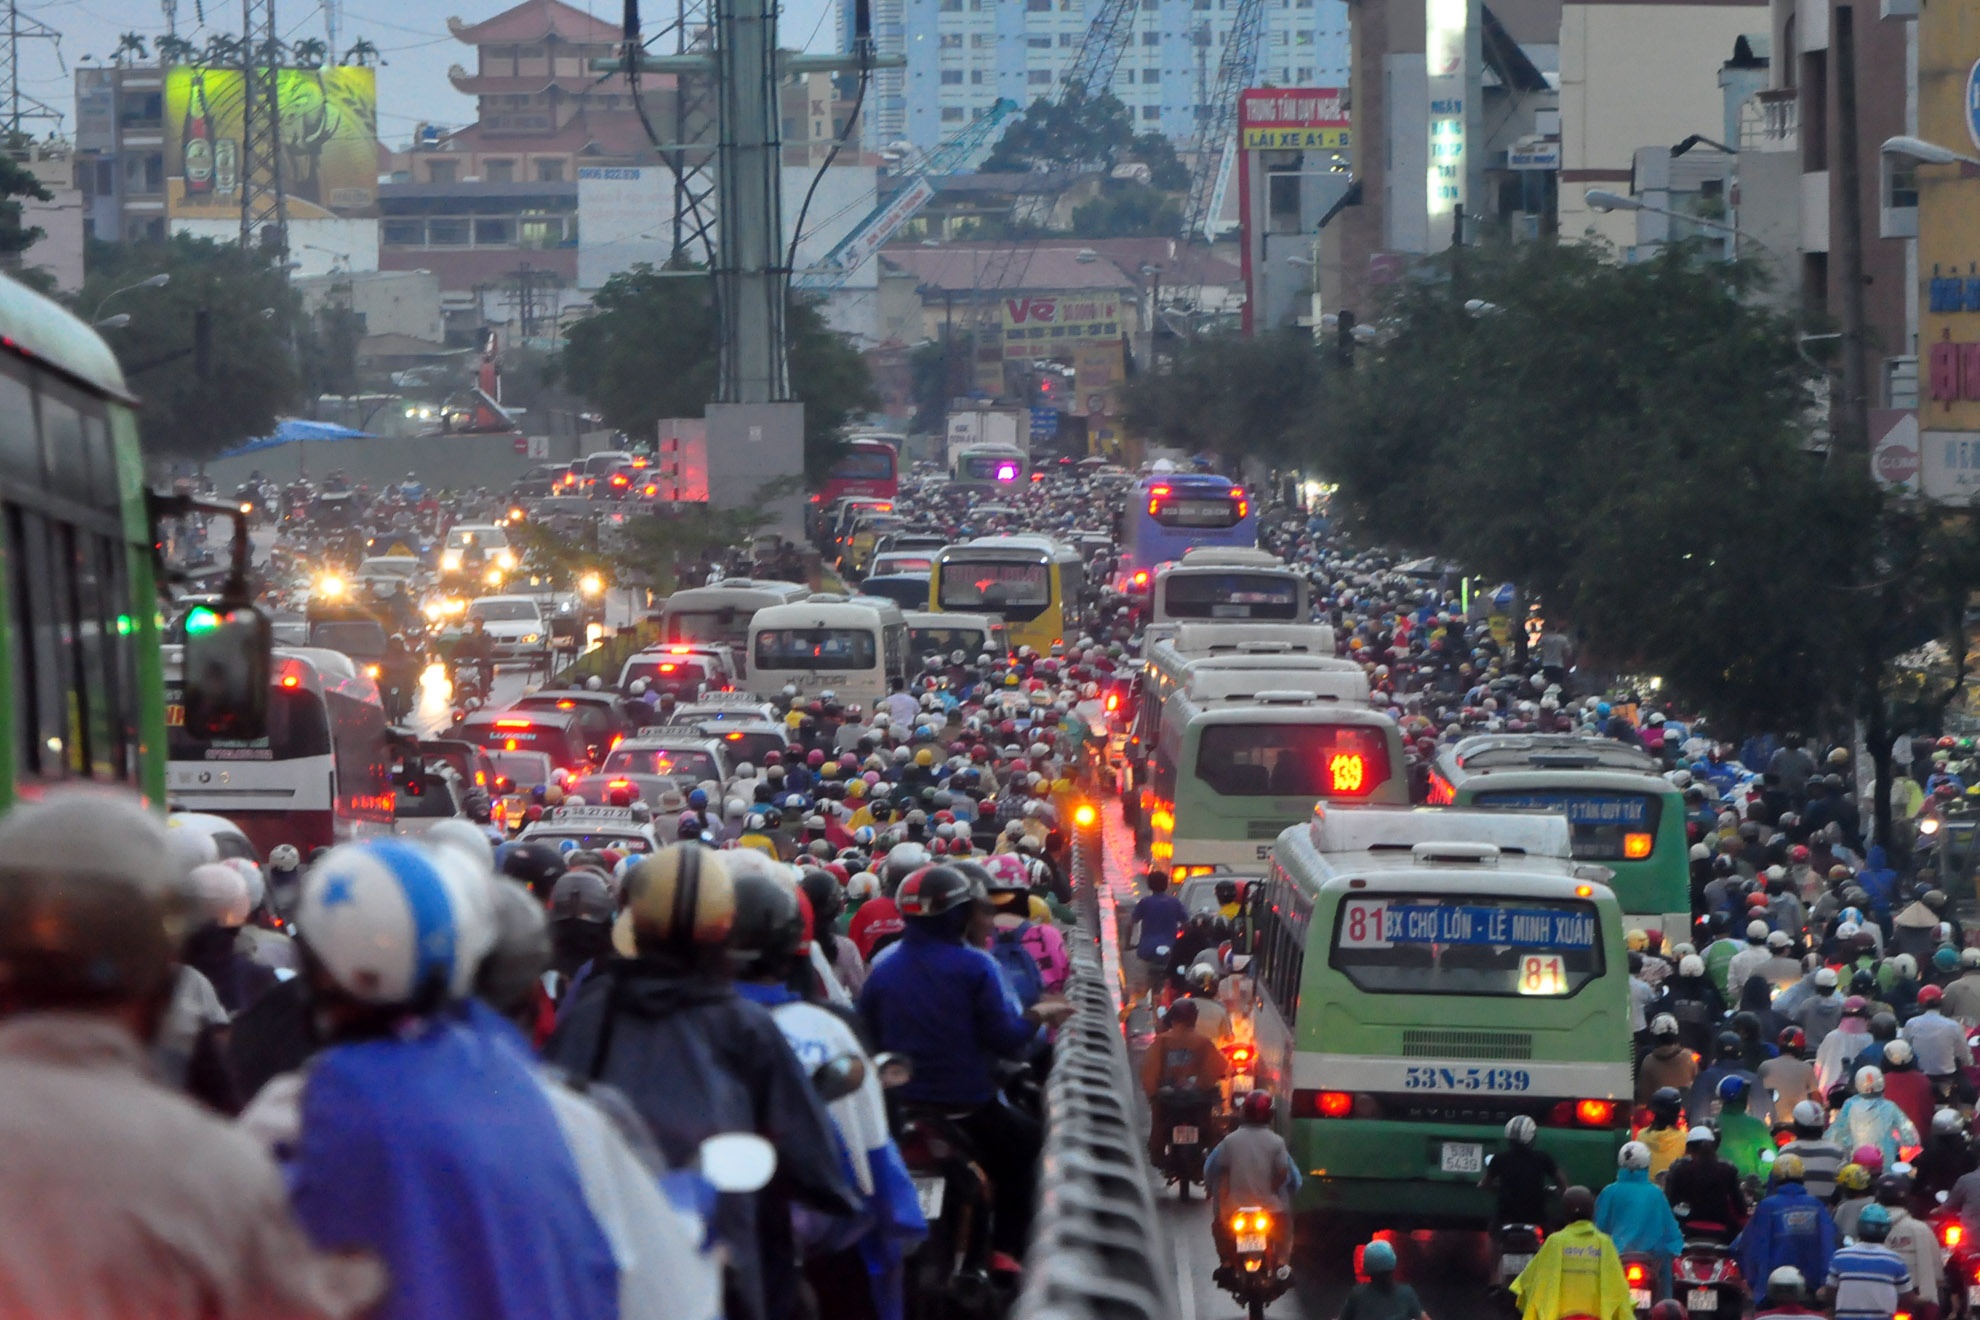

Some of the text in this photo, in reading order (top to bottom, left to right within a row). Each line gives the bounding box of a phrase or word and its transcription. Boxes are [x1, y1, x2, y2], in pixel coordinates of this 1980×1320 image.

[1249, 129, 1275, 146] LÁI
[1281, 133, 1300, 146] XE
[1306, 133, 1323, 146] A1
[1330, 754, 1363, 791] 139
[589, 808, 601, 816] 27
[603, 808, 615, 816] 27
[617, 808, 631, 817] 27
[1578, 801, 1598, 819] TÂN
[1624, 800, 1643, 820] TÂY
[1350, 907, 1383, 942] 81
[1386, 911, 1403, 937] BX
[1408, 908, 1439, 944] CHỢ
[1443, 905, 1471, 939] LỚN
[1488, 909, 1507, 941] LÊ
[1512, 916, 1550, 942] MINH
[1555, 913, 1595, 945] XUÂN
[1526, 957, 1560, 992] 81
[1405, 1067, 1530, 1091] 53N-5439
[1451, 1145, 1475, 1157] 53N
[1446, 1158, 1478, 1170] 5439
